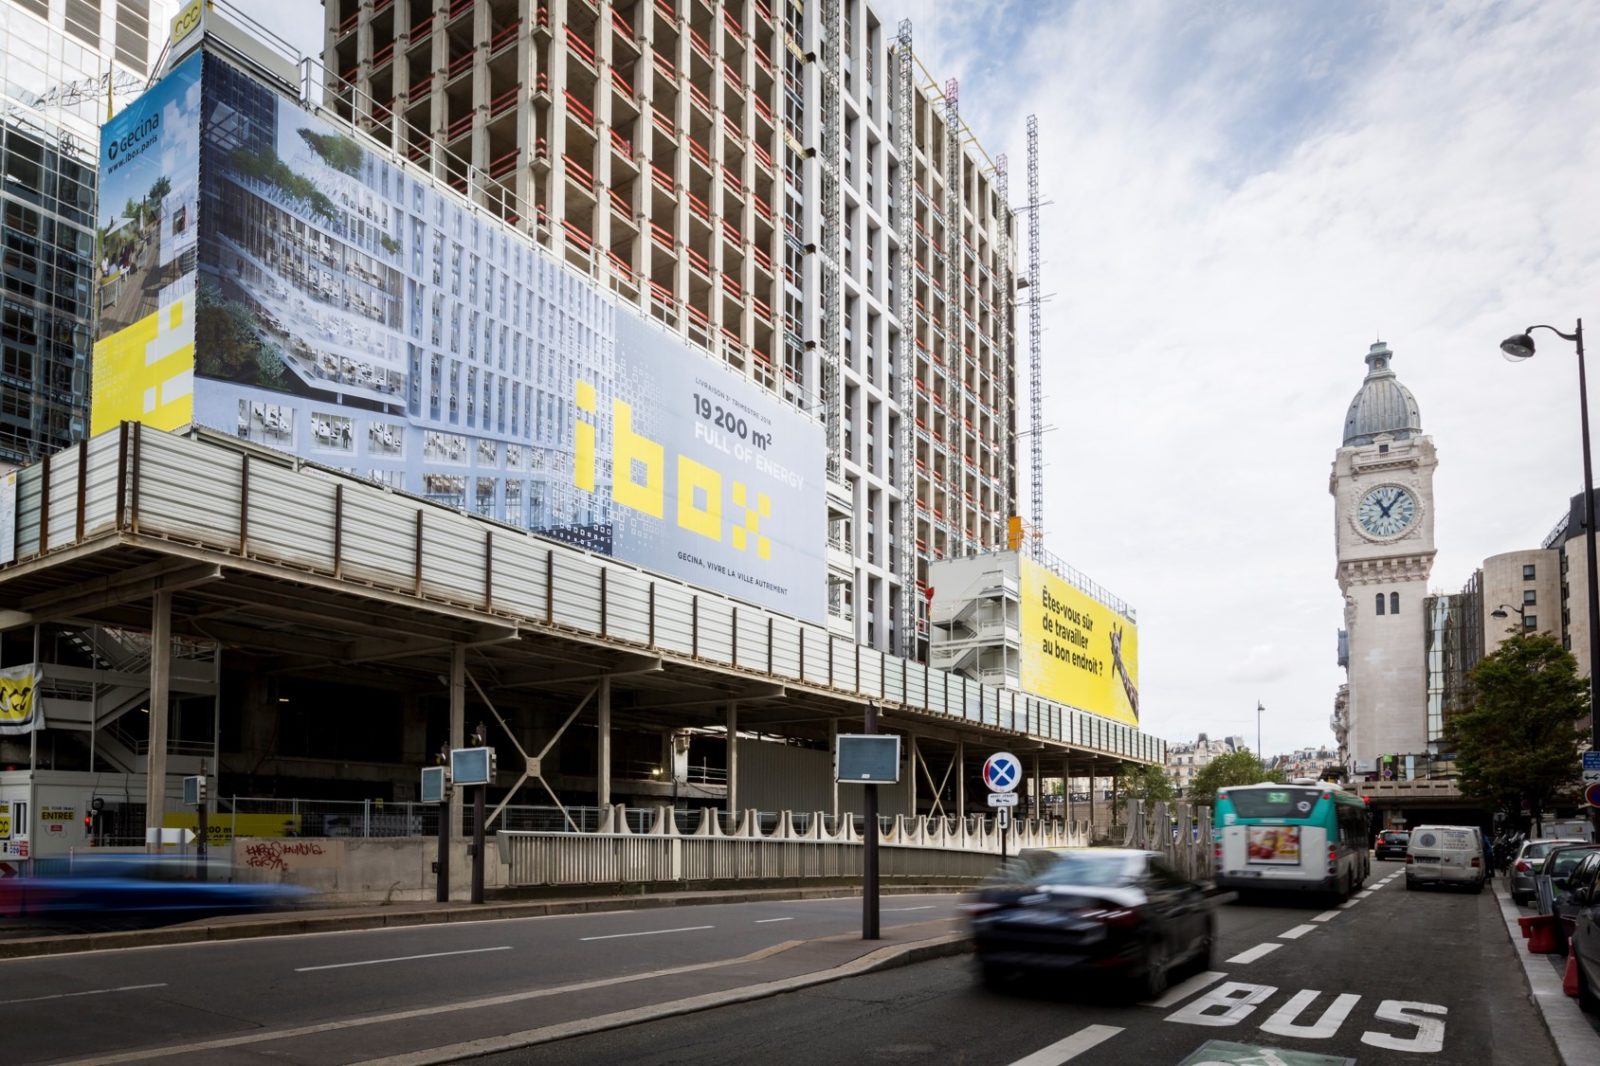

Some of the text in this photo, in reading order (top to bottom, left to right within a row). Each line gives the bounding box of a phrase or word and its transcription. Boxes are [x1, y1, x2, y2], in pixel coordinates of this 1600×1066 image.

[695, 377, 725, 399] LIVRAISON
[732, 399, 760, 419] TRIMESTRE
[695, 421, 804, 492] FULL OF ENERGY
[677, 551, 788, 595] GECINA, VIVRE LA VILLE AUTREMENT
[1042, 585, 1094, 632] Êtes-vous sûr
[1042, 613, 1089, 650] de travailler
[1042, 638, 1053, 656] au
[1055, 639, 1071, 663] bon
[1072, 651, 1098, 676] endroit
[1163, 980, 1449, 1053] BUS
